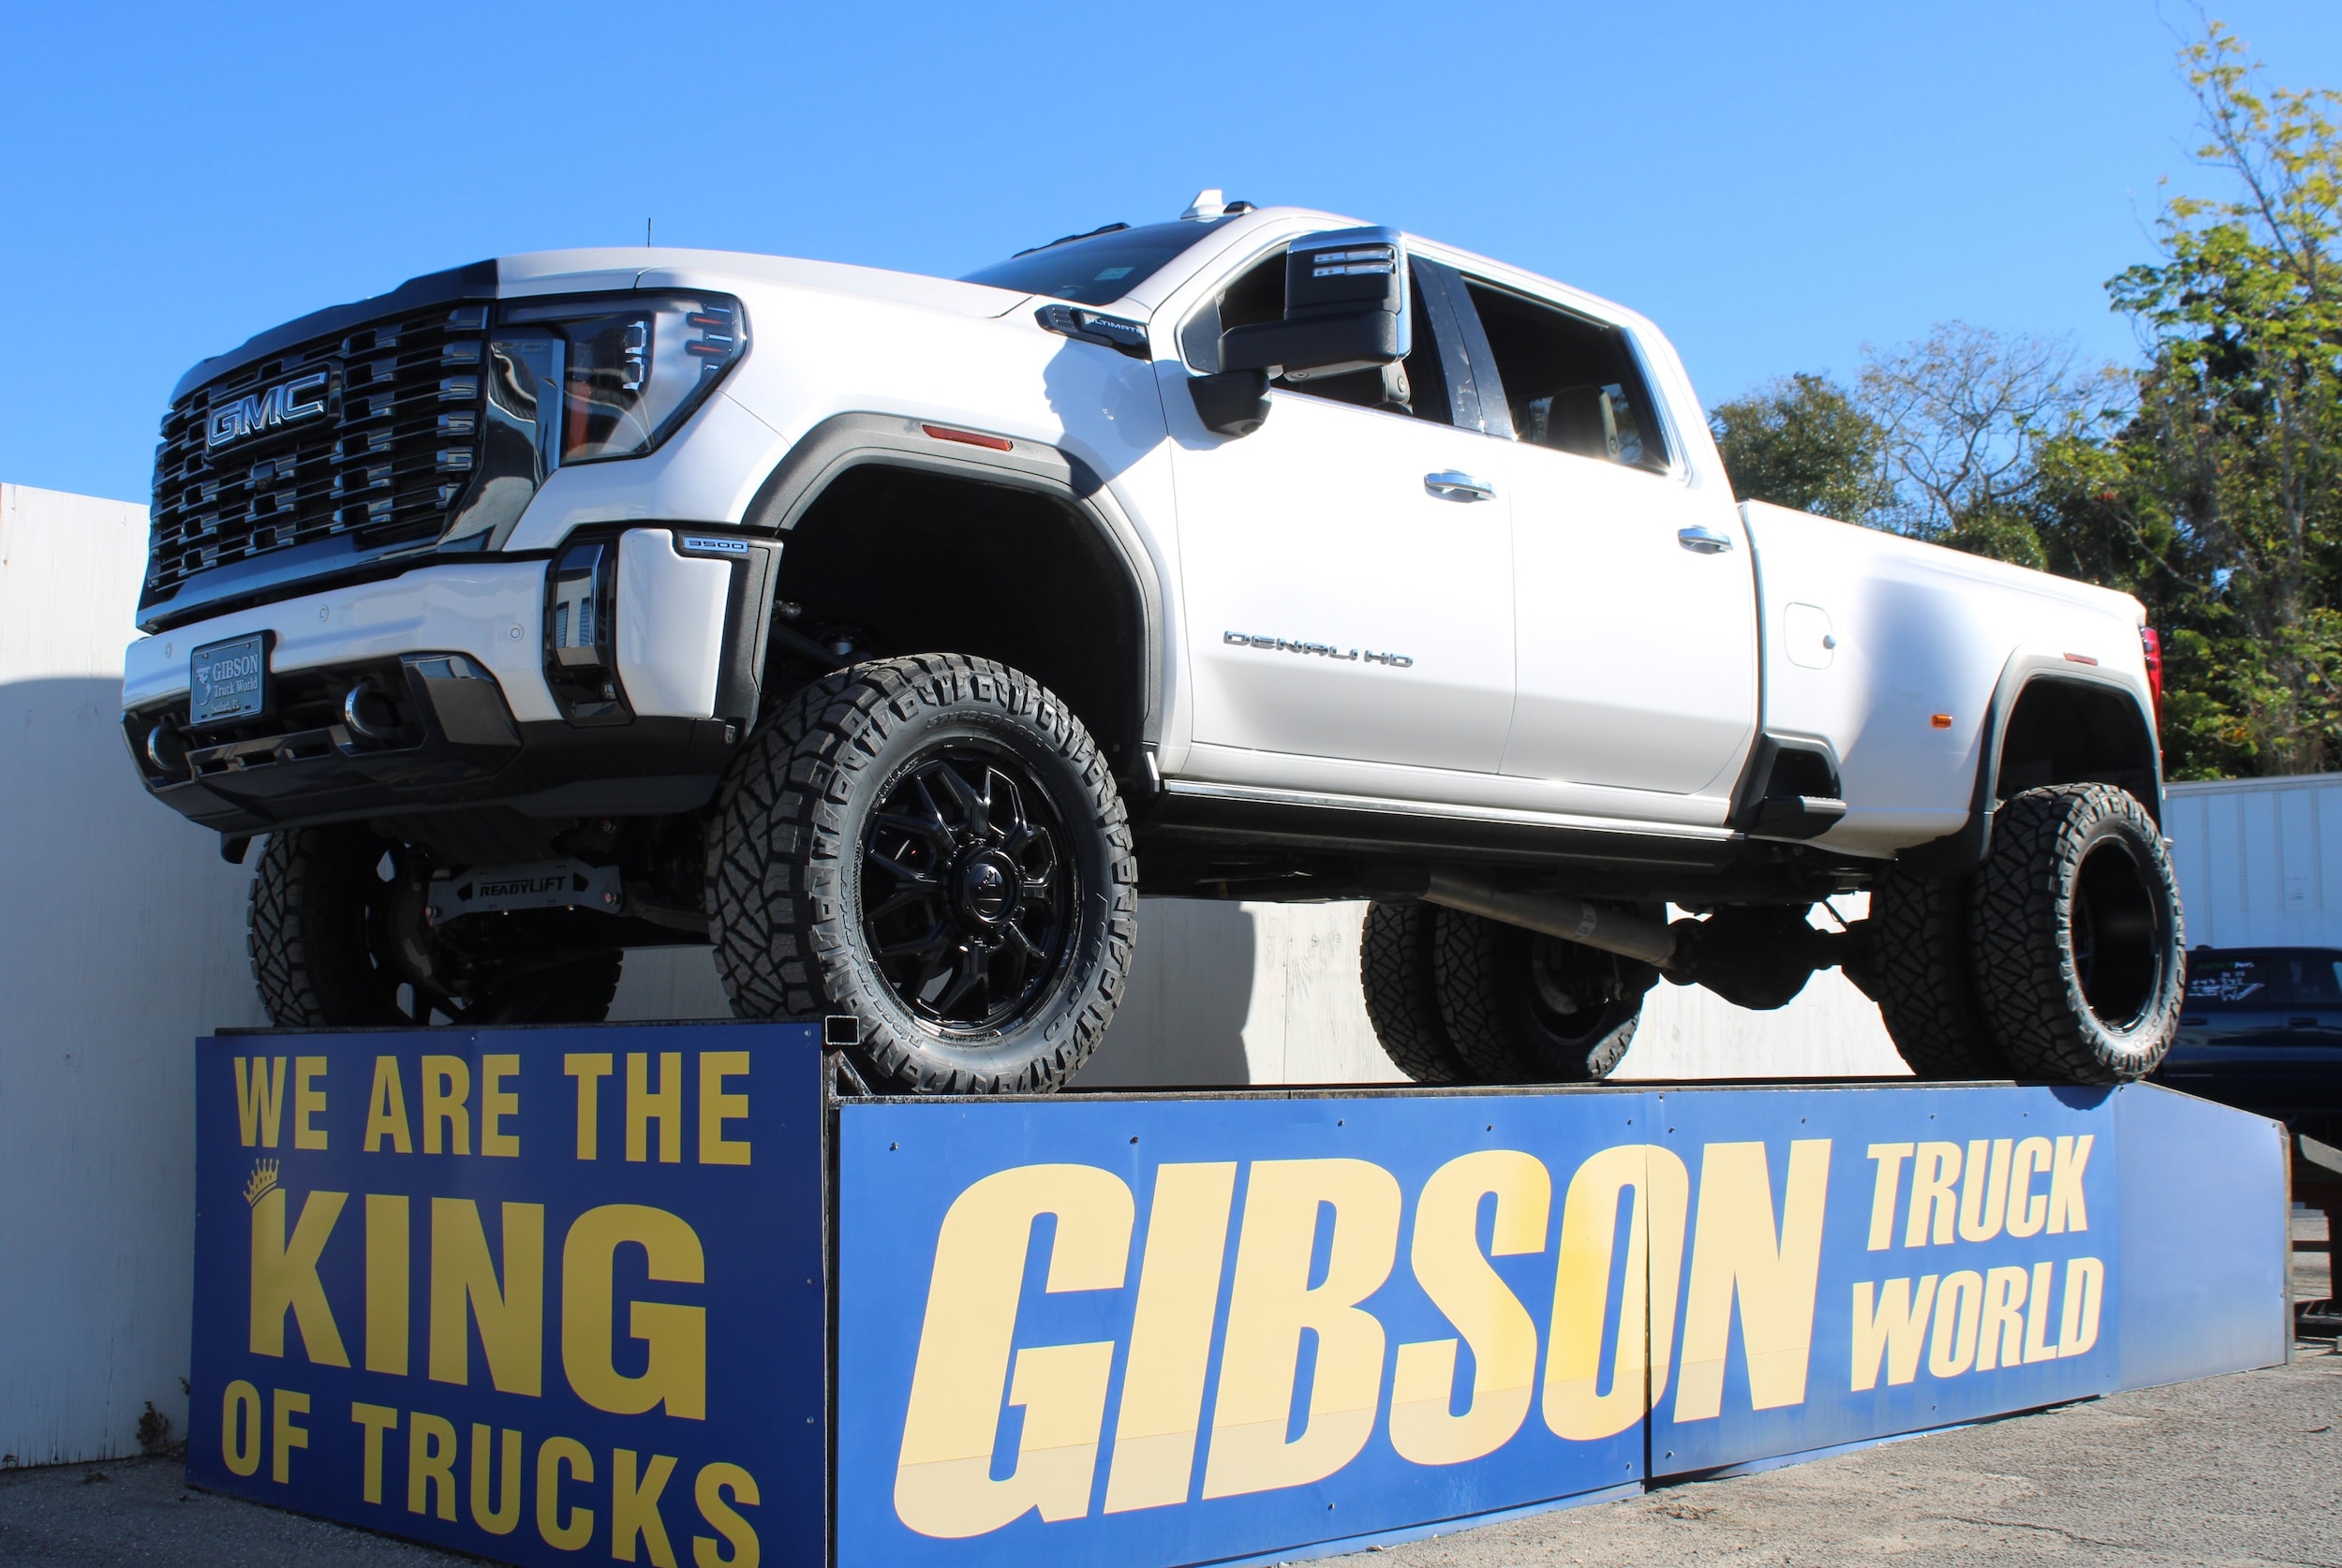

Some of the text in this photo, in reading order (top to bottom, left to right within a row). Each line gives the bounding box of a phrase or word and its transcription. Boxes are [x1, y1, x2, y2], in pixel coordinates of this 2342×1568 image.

[1087, 317, 1142, 333] ULTIMATE
[207, 372, 327, 447] GMC
[689, 540, 744, 550] 3500
[213, 654, 259, 682] GIBSON
[1223, 630, 1414, 668] DENALI HD
[214, 676, 259, 698] Truck World
[479, 876, 567, 897] READYLIFT
[233, 1051, 751, 1165] WE ARE THE
[1866, 1134, 2095, 1251] TRUCK
[249, 1188, 706, 1421] KING
[894, 1138, 1832, 1539] GIBSON
[1850, 1257, 2104, 1393] WORLD
[221, 1380, 761, 1568] OF TRUCKS
